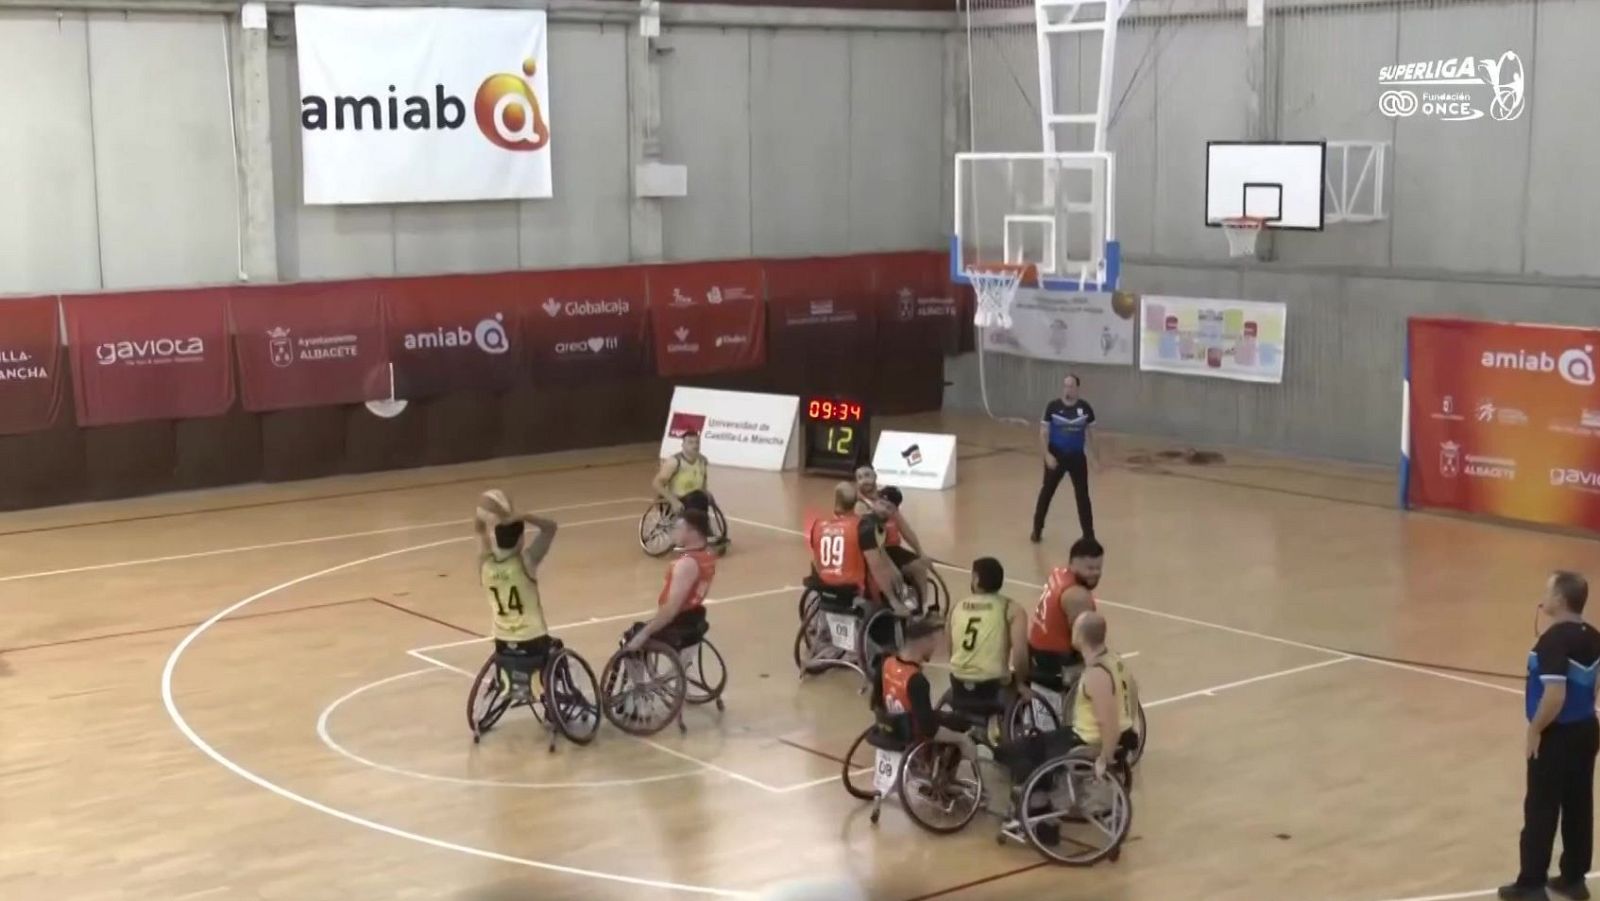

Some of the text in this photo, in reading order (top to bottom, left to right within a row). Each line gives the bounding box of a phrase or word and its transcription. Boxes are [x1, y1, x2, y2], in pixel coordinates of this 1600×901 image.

[301, 84, 466, 130] amiab
[565, 299, 629, 316] Globalcaja
[96, 337, 204, 365] gaviota
[404, 327, 472, 350] amiab
[1481, 350, 1554, 372] amiab
[809, 401, 861, 420] 09:34
[827, 426, 853, 454] 12
[820, 536, 844, 566] 09
[489, 585, 524, 616] 14
[962, 617, 981, 650] 5
